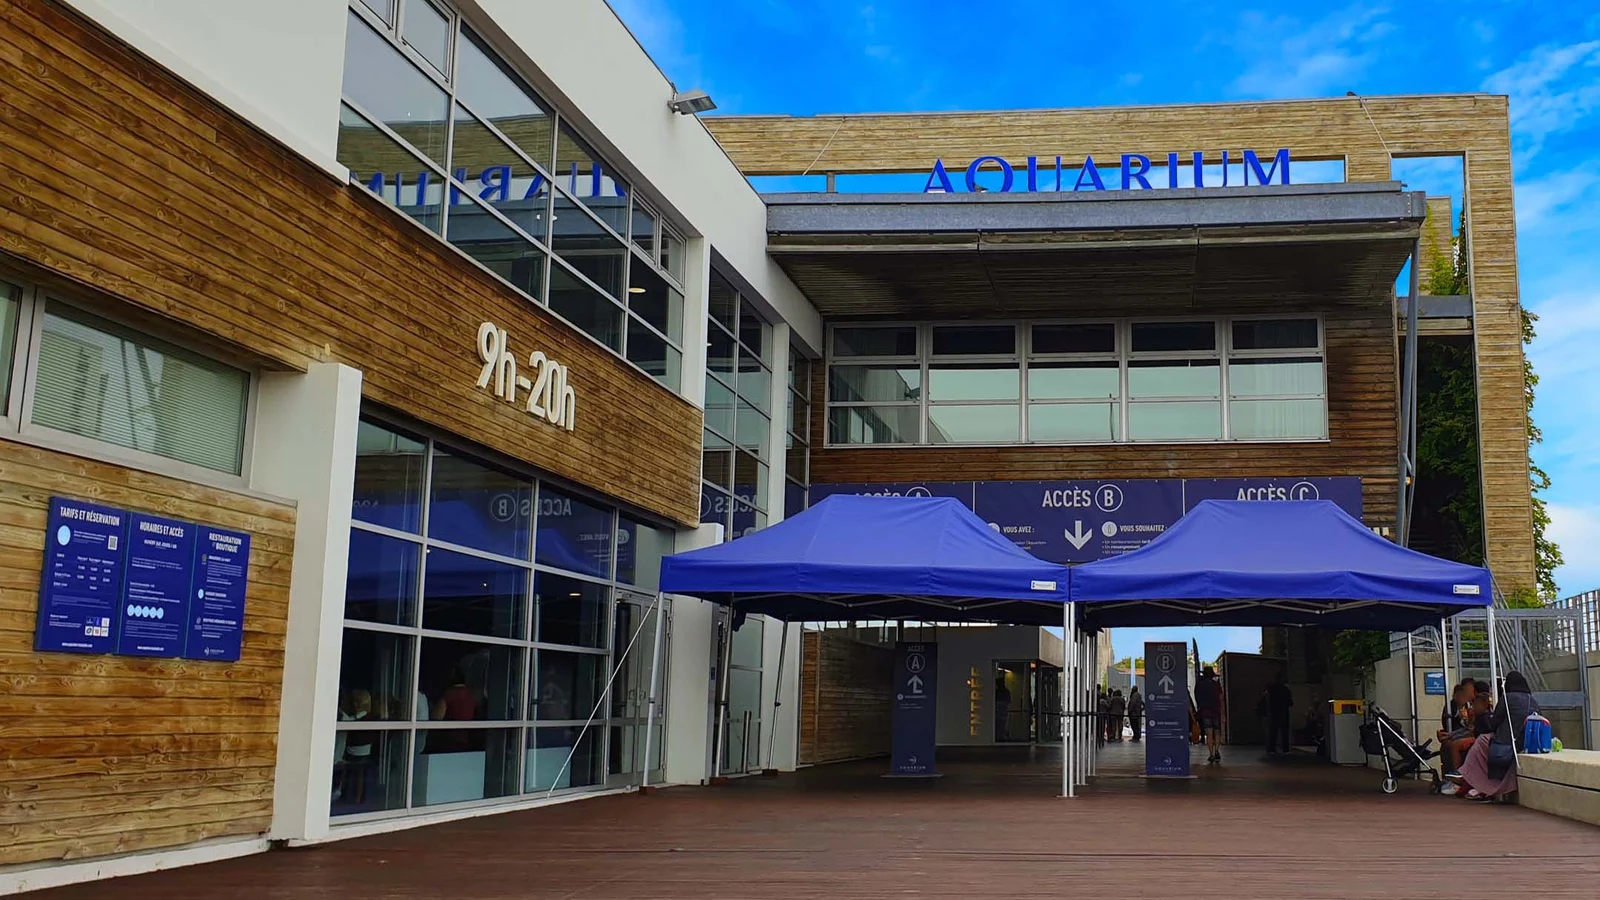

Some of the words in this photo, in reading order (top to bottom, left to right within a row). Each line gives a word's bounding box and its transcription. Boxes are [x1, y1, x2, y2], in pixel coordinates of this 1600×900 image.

[923, 148, 1291, 193] AQUARIUM
[476, 322, 576, 431] 9h-20h
[1042, 486, 1092, 508] ACCÈS
[1104, 489, 1114, 507] B
[60, 506, 79, 519] TARIFS
[79, 510, 87, 520] ET
[86, 510, 120, 526] RÉSERVATION
[140, 521, 163, 535] HORAIRES
[163, 526, 169, 536] ET
[169, 526, 184, 538] ACCÈS
[1002, 525, 1018, 534] VOUS
[1018, 525, 1032, 533] AVEZ
[208, 533, 242, 546] RESTAURATION
[215, 542, 238, 554] BOUTIQUE
[911, 655, 920, 670] A
[1162, 655, 1170, 670] B
